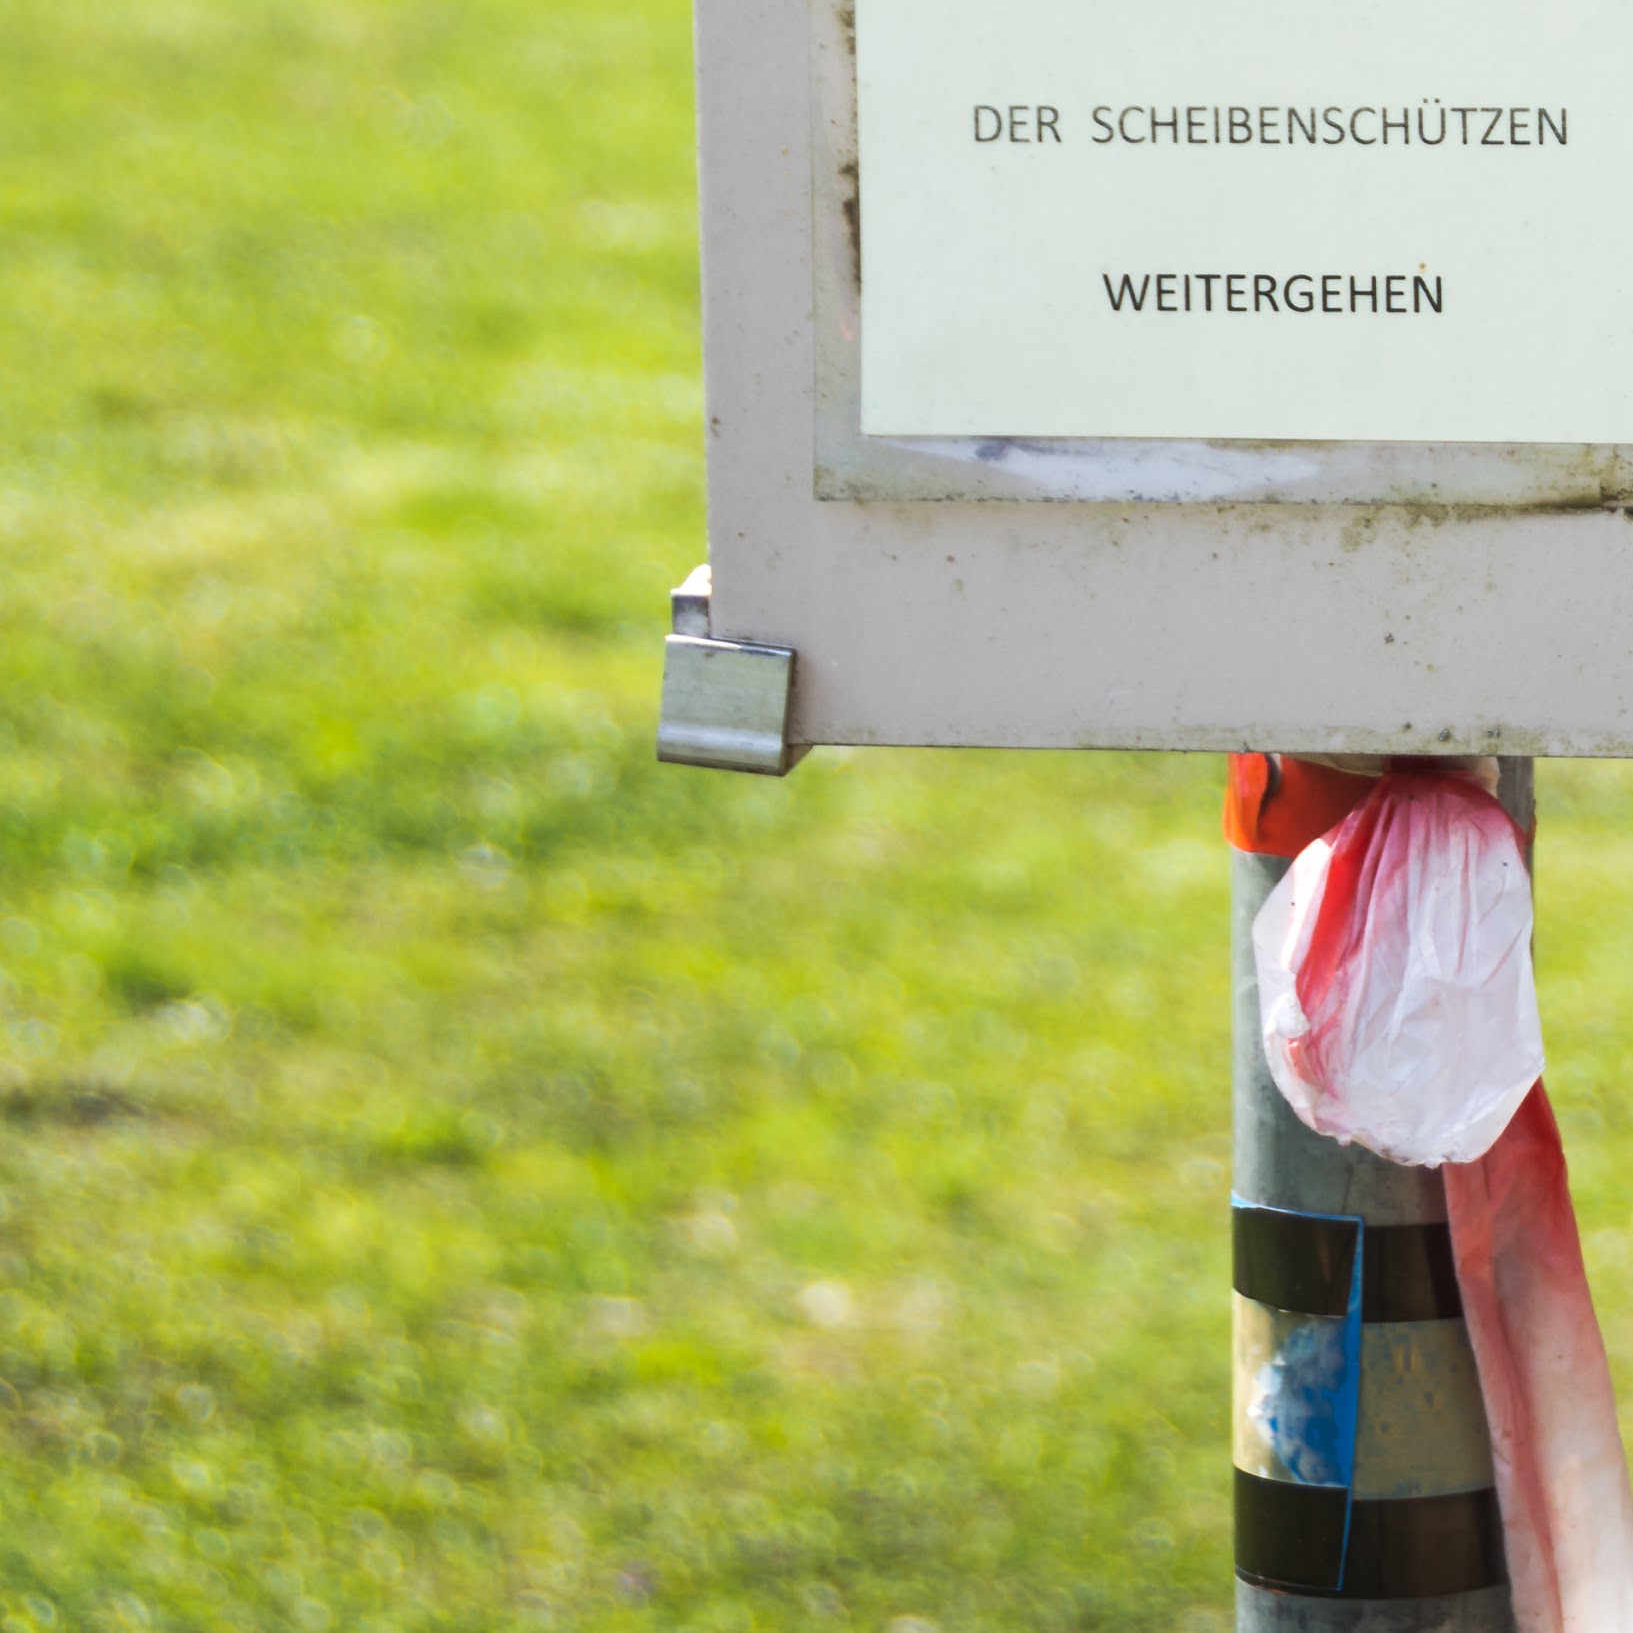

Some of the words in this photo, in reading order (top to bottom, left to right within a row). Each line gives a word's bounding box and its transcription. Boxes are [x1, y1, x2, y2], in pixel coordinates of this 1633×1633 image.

[972, 103, 1062, 144] DER
[1090, 98, 1569, 146] SCHEIBENSCHÜTZEN
[1102, 272, 1444, 314] WEITERGEHEN
